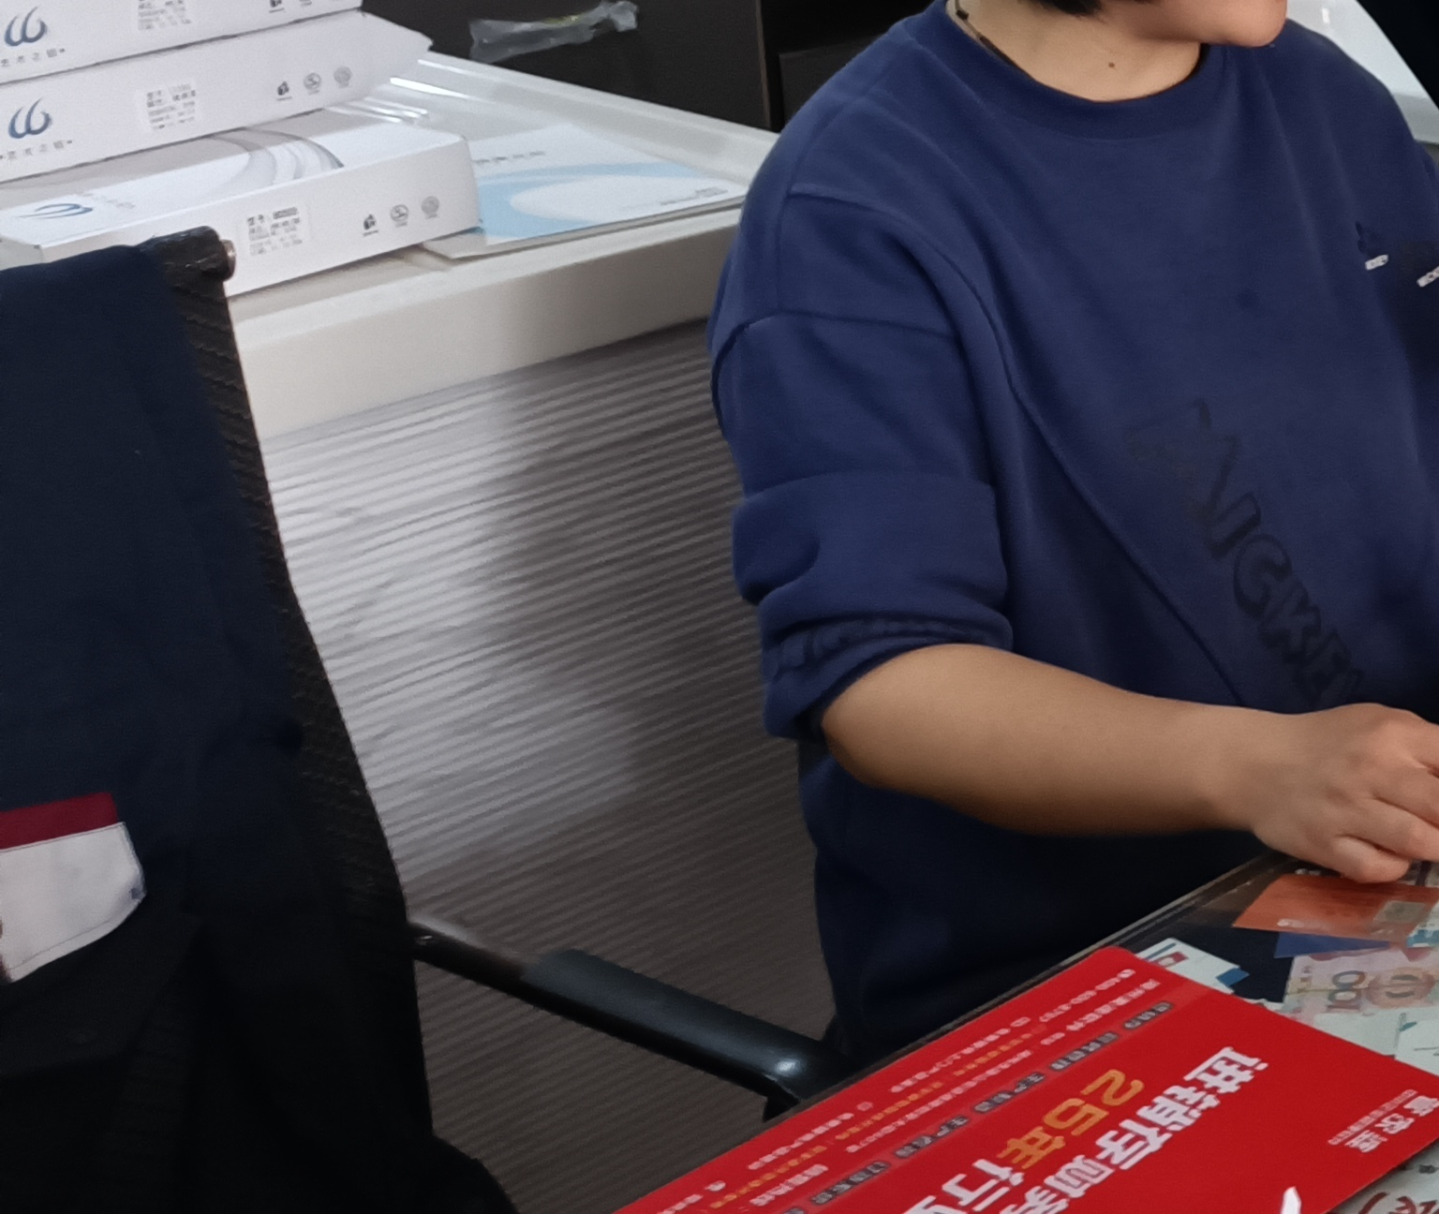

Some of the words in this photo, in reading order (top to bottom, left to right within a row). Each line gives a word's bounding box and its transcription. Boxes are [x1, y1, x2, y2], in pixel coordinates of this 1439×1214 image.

[996, 1046, 1272, 1213] 进销存财务
